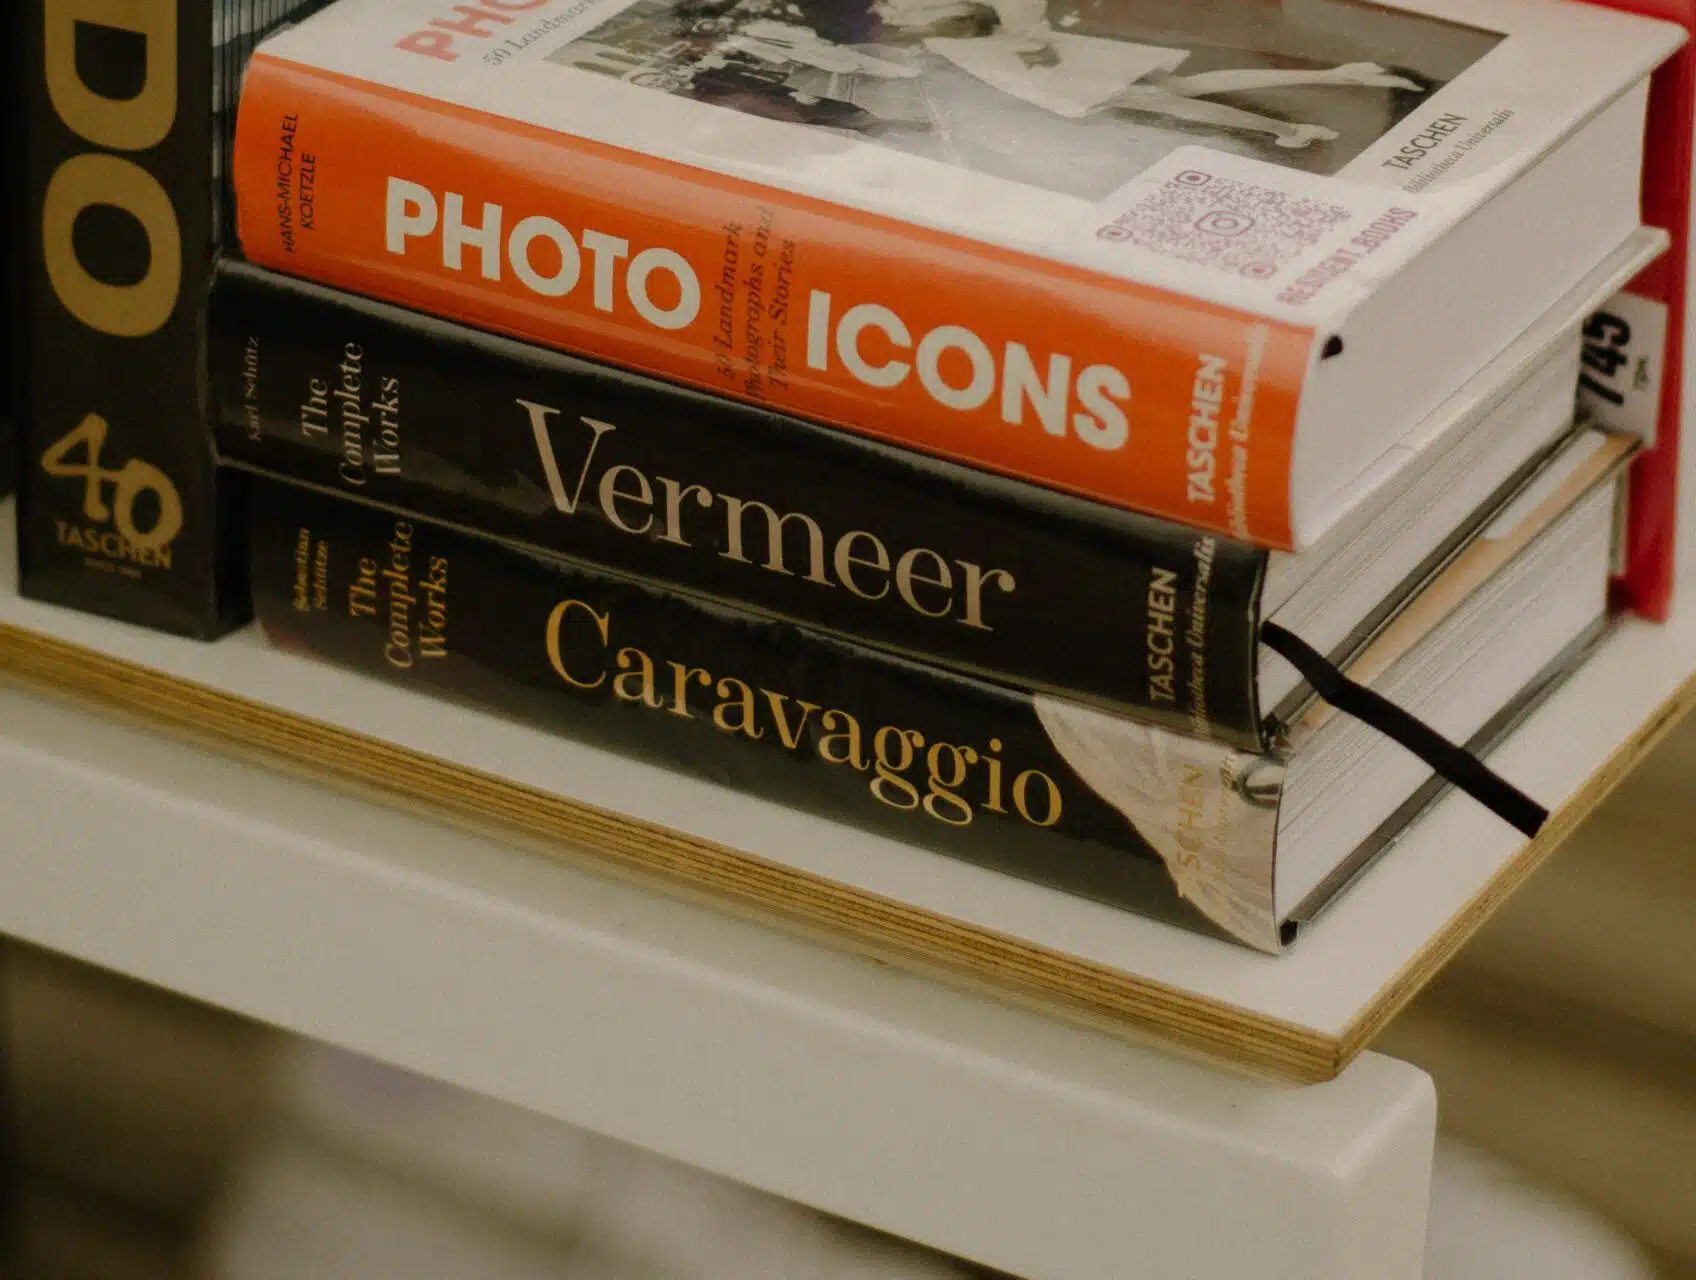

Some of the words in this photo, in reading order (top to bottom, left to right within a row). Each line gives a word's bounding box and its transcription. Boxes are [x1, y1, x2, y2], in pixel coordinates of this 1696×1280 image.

[481, 44, 511, 67] 50
[276, 113, 298, 253] HANS-MICHAEL
[300, 152, 316, 229] KOETZLE
[1381, 112, 1468, 170] TASCHEN
[1402, 149, 1465, 195] Bibliotheca
[1456, 108, 1515, 152] Universalis
[753, 205, 776, 257] and
[768, 239, 797, 325] Stories
[384, 176, 702, 330] PHOTO
[806, 288, 1132, 452] ICONS
[713, 220, 743, 350] Landmark
[302, 377, 329, 438] The
[767, 327, 789, 390] Their
[333, 342, 370, 486] Complete
[372, 375, 401, 475] Works
[1186, 352, 1228, 504] TASCHEN
[41, 411, 183, 550] 40
[516, 398, 1016, 632] Vermeer
[55, 519, 172, 570] TASCHEN
[350, 557, 377, 617] The
[383, 521, 418, 669] Complete
[1185, 535, 1217, 648] Universalis
[418, 556, 449, 658] Works
[1147, 566, 1178, 701] TASCHEN
[545, 599, 1063, 827] Caravaggio
